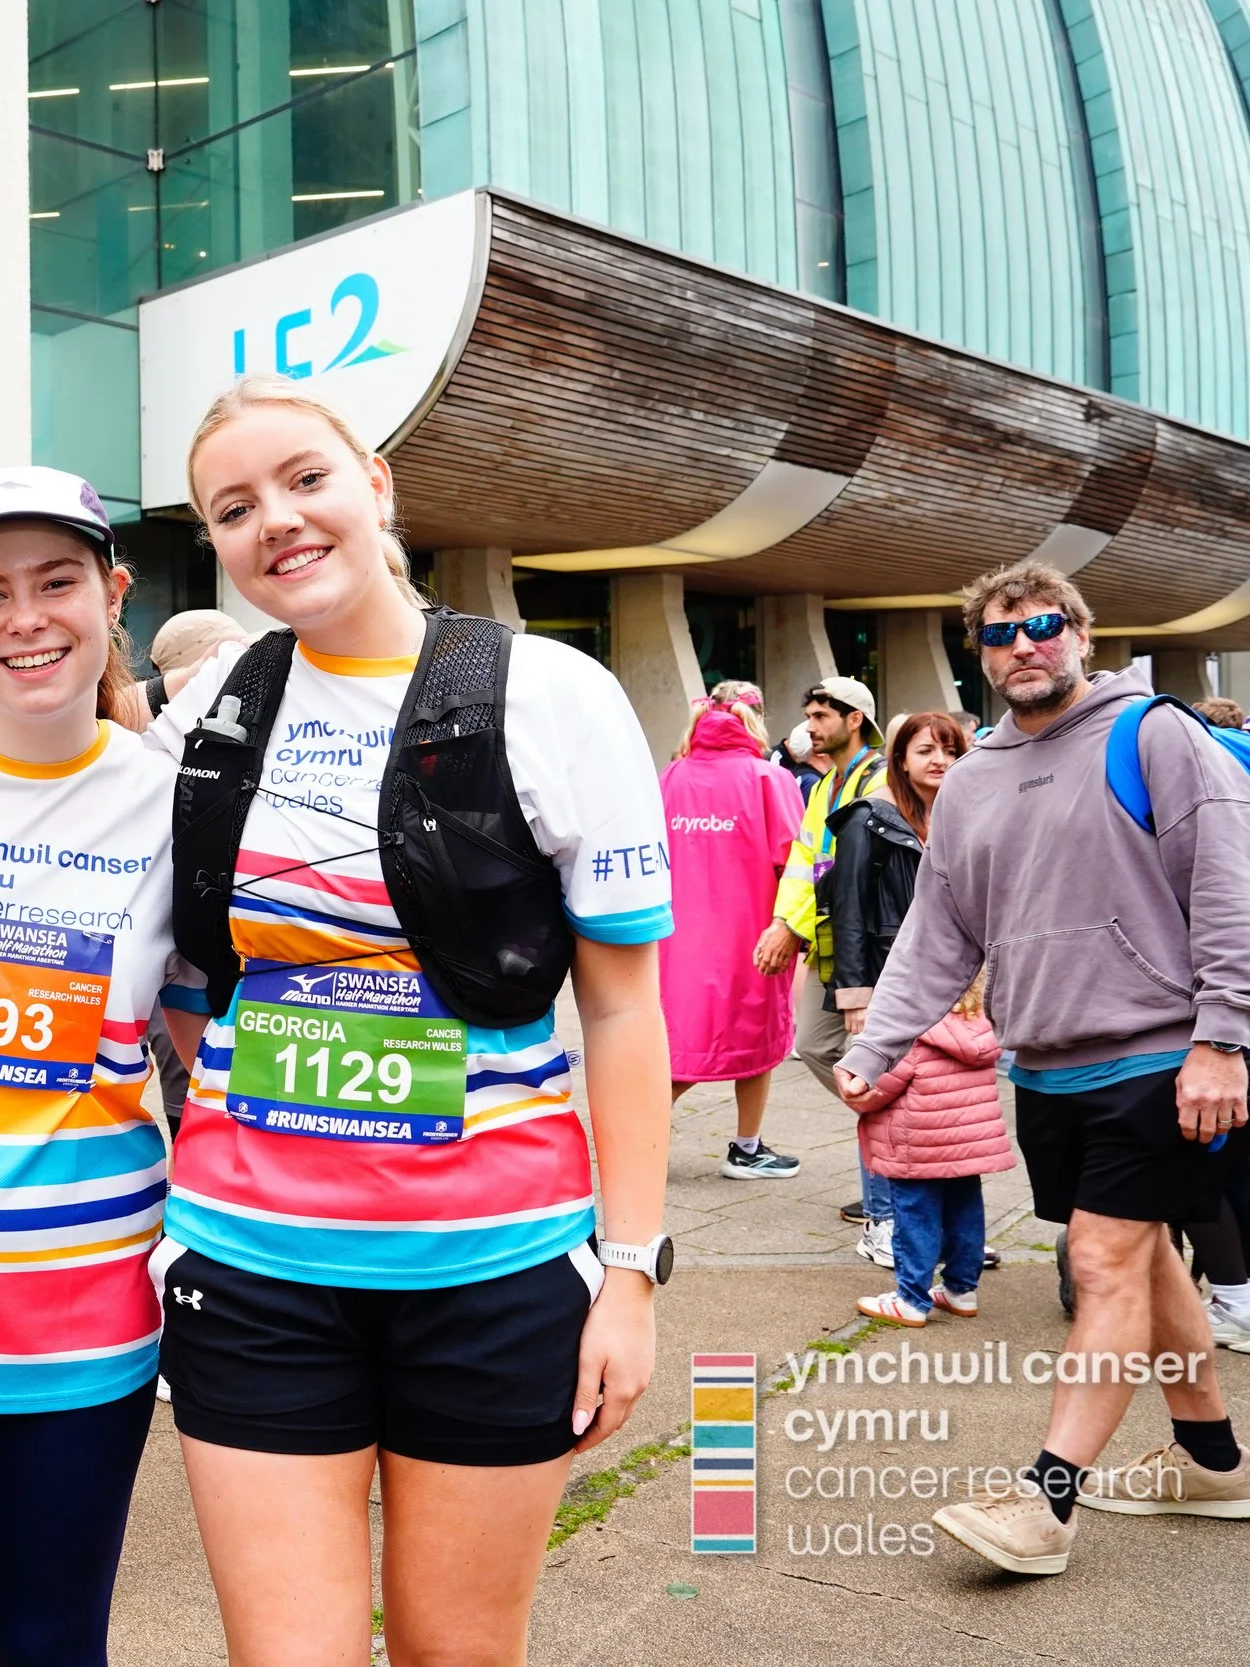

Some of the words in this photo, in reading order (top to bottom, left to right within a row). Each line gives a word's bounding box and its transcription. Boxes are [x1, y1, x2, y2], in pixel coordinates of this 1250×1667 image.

[284, 719, 395, 749] ymcwil
[276, 747, 362, 767] cymru
[1017, 772, 1055, 794] gymshark
[265, 788, 343, 815] wales
[671, 813, 735, 835] dryrobe
[58, 849, 152, 875] canser
[19, 904, 133, 930] research
[7, 952, 37, 962] MARATHON
[36, 957, 65, 966] ABERTAWE
[69, 981, 103, 994] CANCER
[337, 971, 421, 994] SWANSEA
[28, 988, 72, 1003] RESEARCH
[73, 992, 101, 1006] WALES
[358, 1003, 389, 1011] MARATHON
[389, 1005, 420, 1013] ABERTAWE
[239, 1010, 347, 1044] GEORGIA
[426, 1028, 462, 1039] CANCER
[383, 1039, 431, 1051] RESEARCH
[432, 1041, 462, 1052] WALES
[275, 1043, 413, 1104] 1129
[265, 1109, 413, 1140] #RUNSWANSEA
